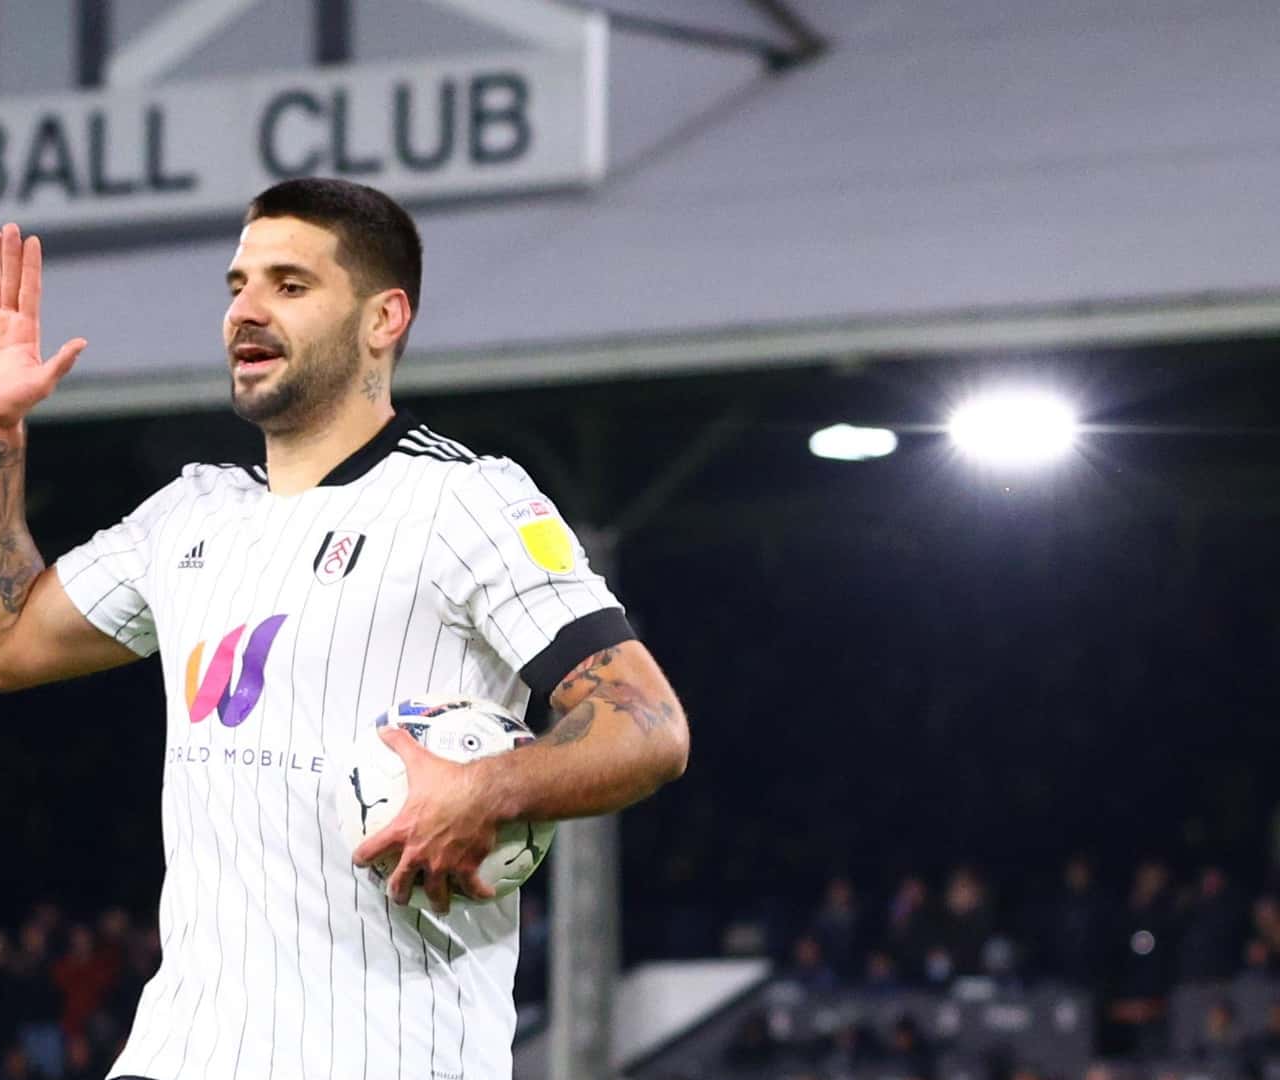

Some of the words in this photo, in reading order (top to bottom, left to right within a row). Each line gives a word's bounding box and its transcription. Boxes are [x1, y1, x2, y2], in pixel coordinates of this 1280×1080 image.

[256, 72, 536, 179] CLUB
[167, 745, 210, 764] ORLD
[224, 748, 325, 773] MOBILE
